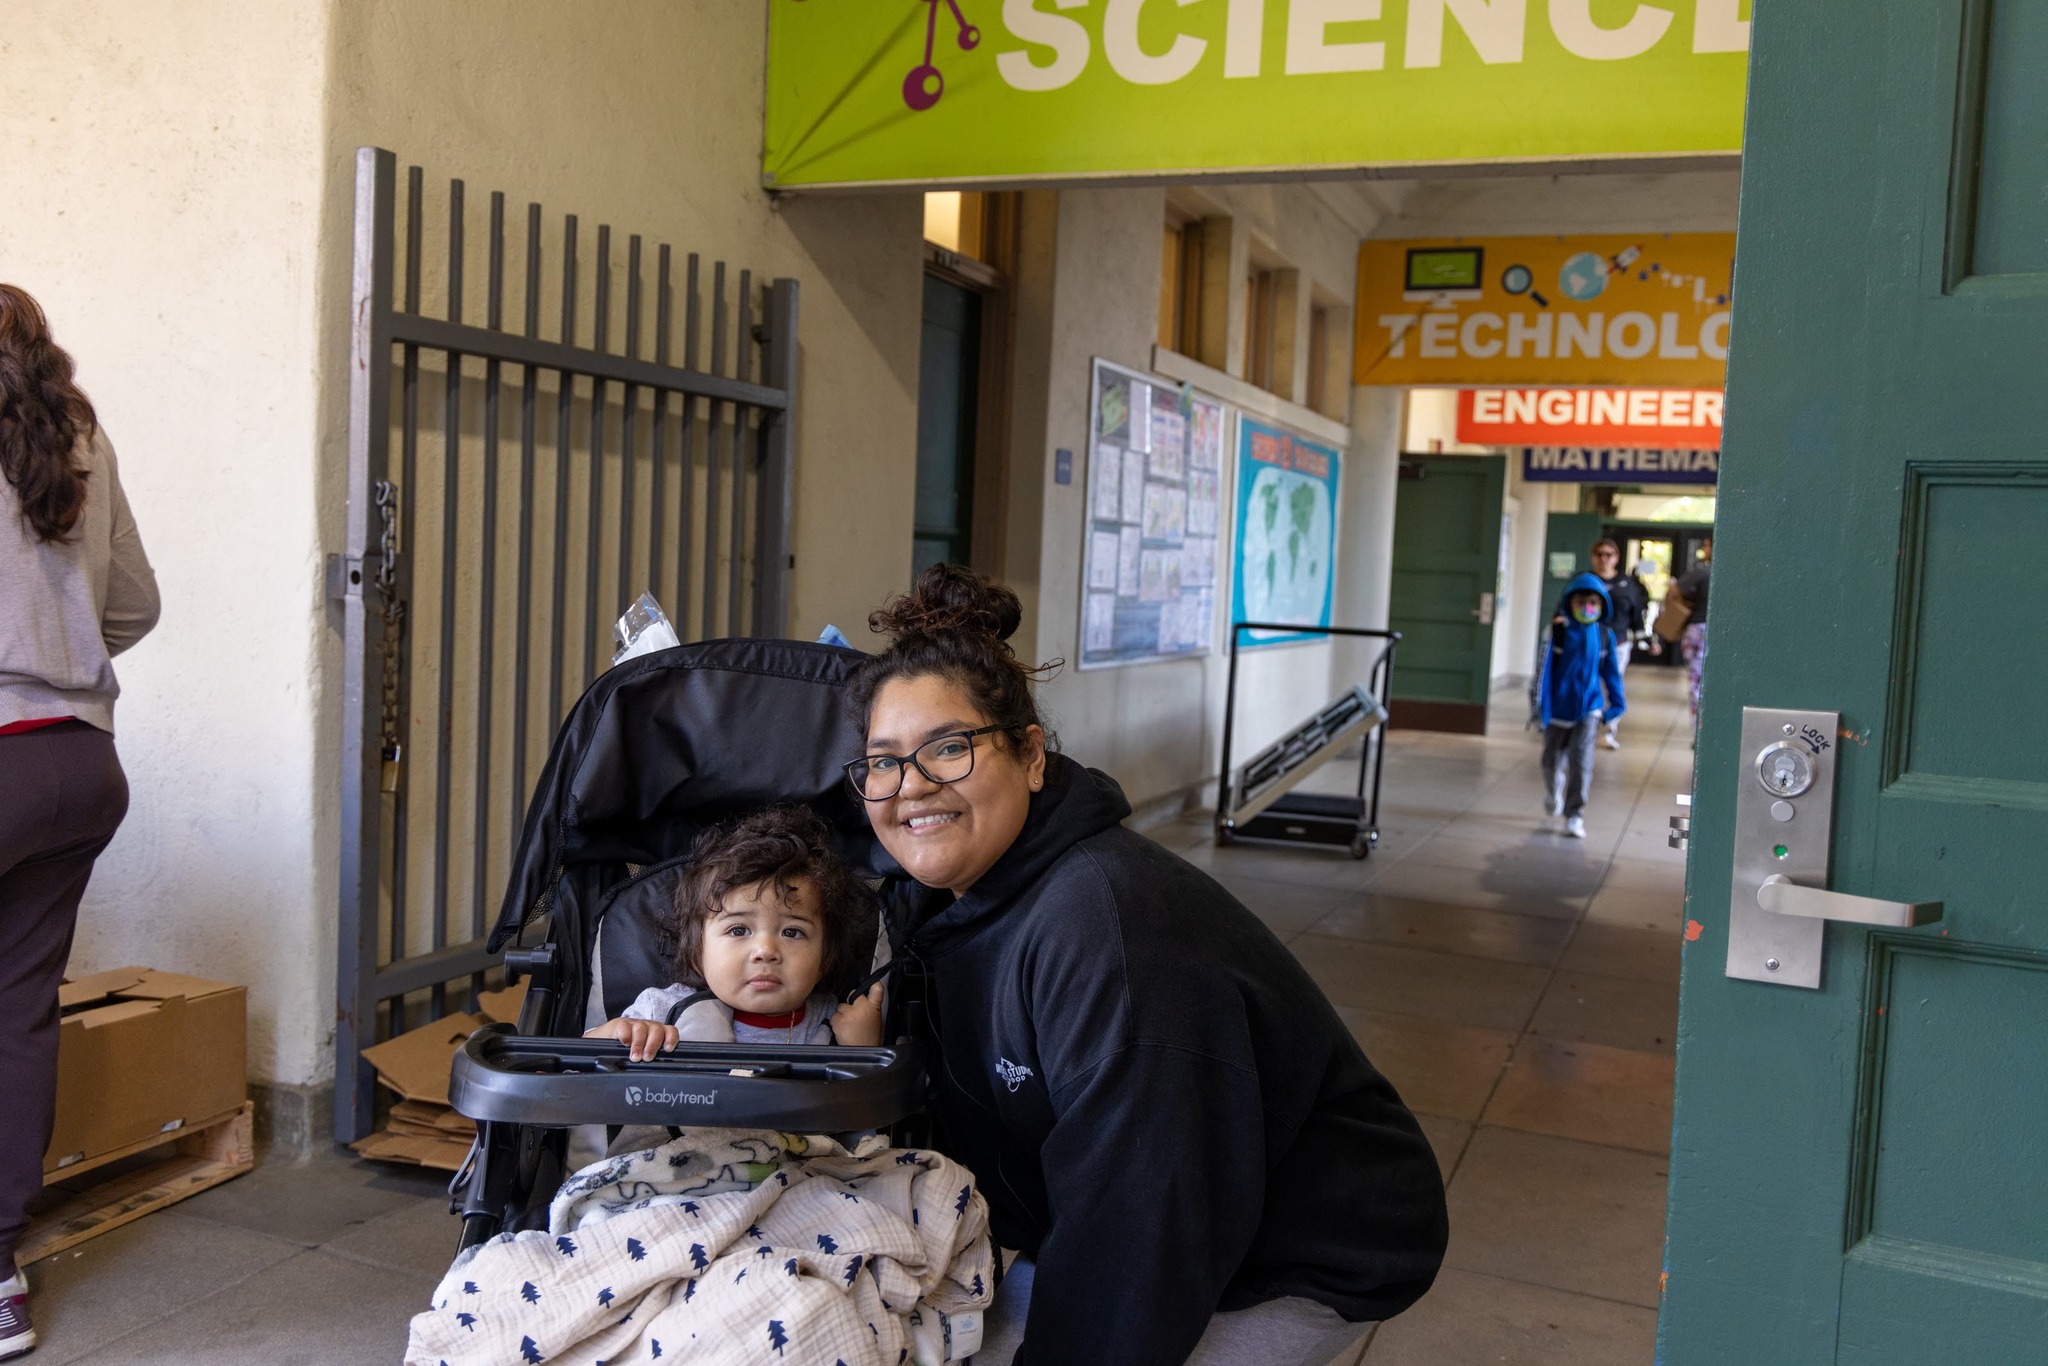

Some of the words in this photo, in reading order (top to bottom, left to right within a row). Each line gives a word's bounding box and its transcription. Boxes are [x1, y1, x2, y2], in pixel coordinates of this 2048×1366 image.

[996, 0, 1751, 91] SCIENC
[1473, 390, 1724, 427] ENGINEER
[1529, 449, 1719, 473] MATHEMA
[1802, 724, 1831, 751] LOCK
[645, 1086, 716, 1107] babytrend
